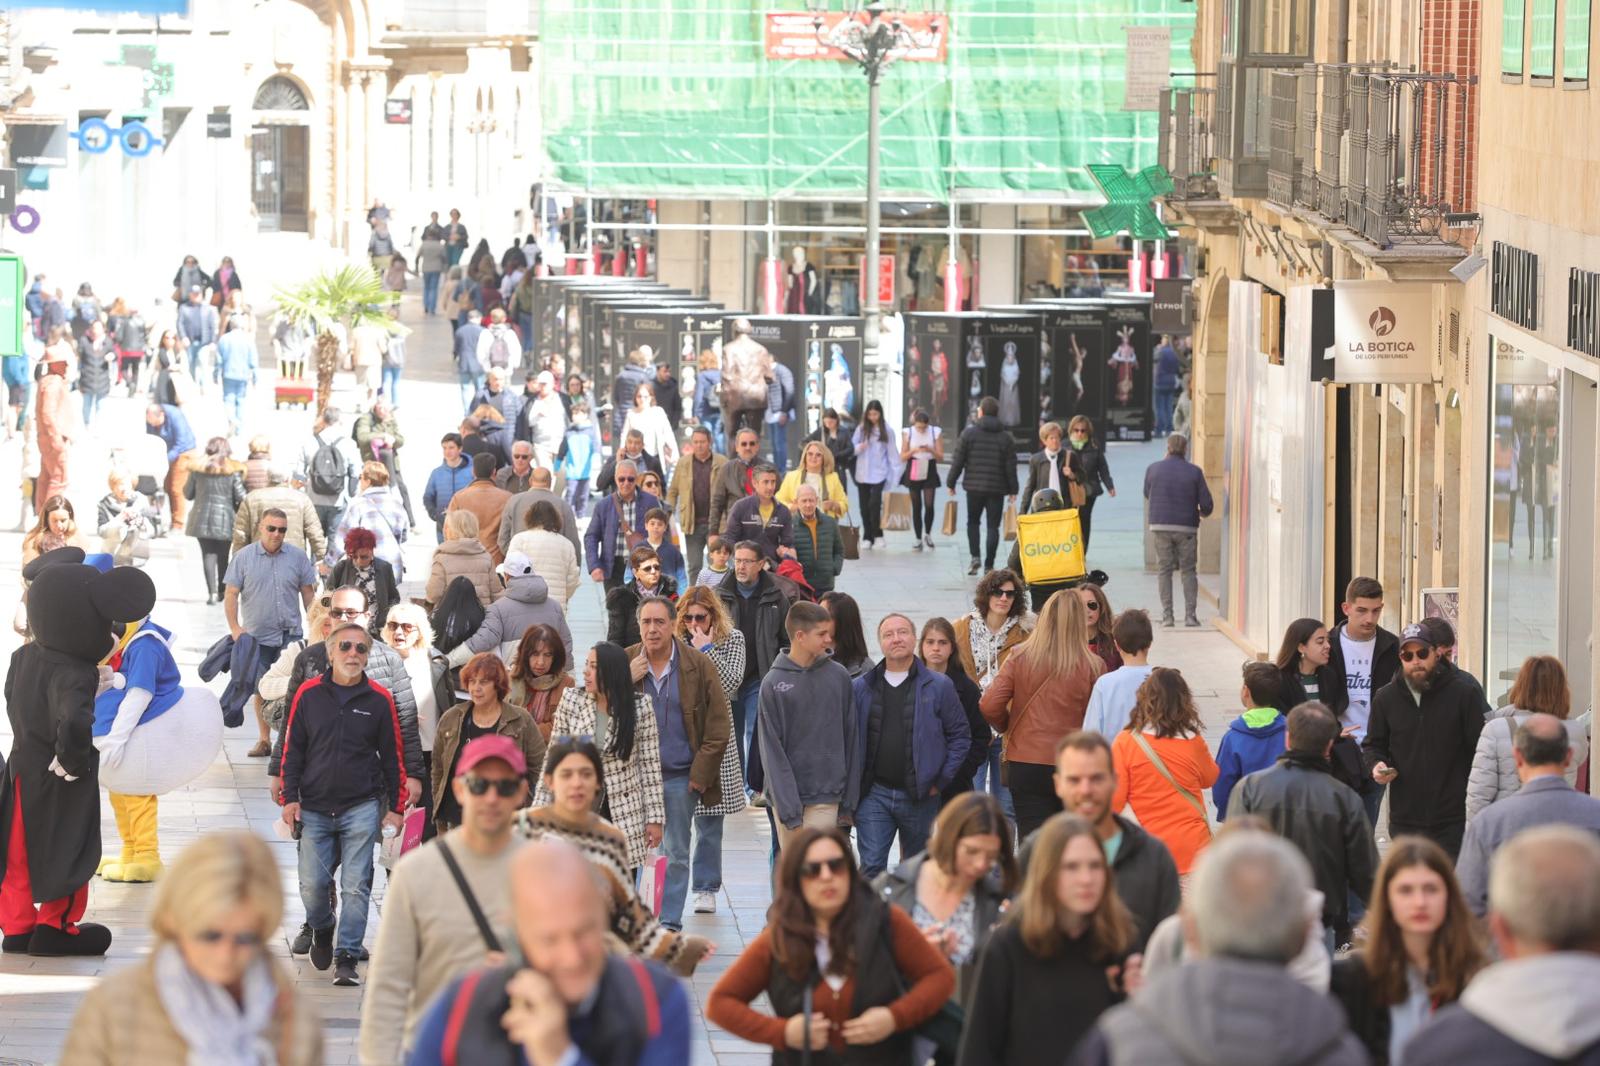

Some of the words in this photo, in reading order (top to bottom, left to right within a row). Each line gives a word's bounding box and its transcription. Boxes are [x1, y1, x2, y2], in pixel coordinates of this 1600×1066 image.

[1348, 342, 1365, 352] LA
[1368, 342, 1415, 352] BOTICA
[1024, 542, 1072, 557] Glovo
[1346, 671, 1371, 690] atri
